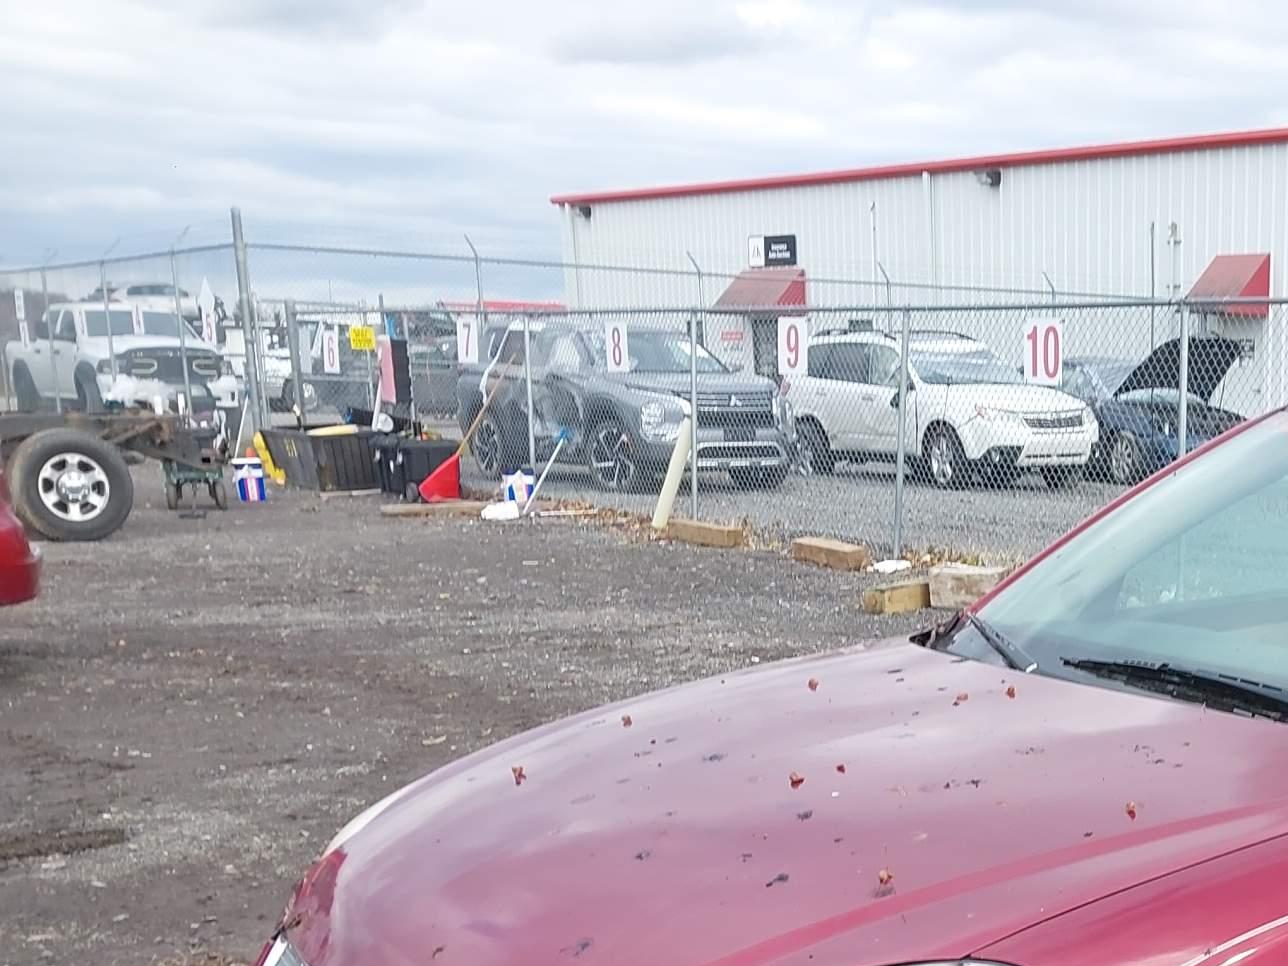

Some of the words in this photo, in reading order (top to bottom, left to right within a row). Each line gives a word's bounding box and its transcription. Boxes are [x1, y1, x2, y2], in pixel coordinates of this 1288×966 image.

[326, 336, 336, 368] 6
[462, 322, 471, 359] 7
[611, 326, 623, 367] 8
[785, 323, 800, 369] 9
[1026, 325, 1060, 379] 10
